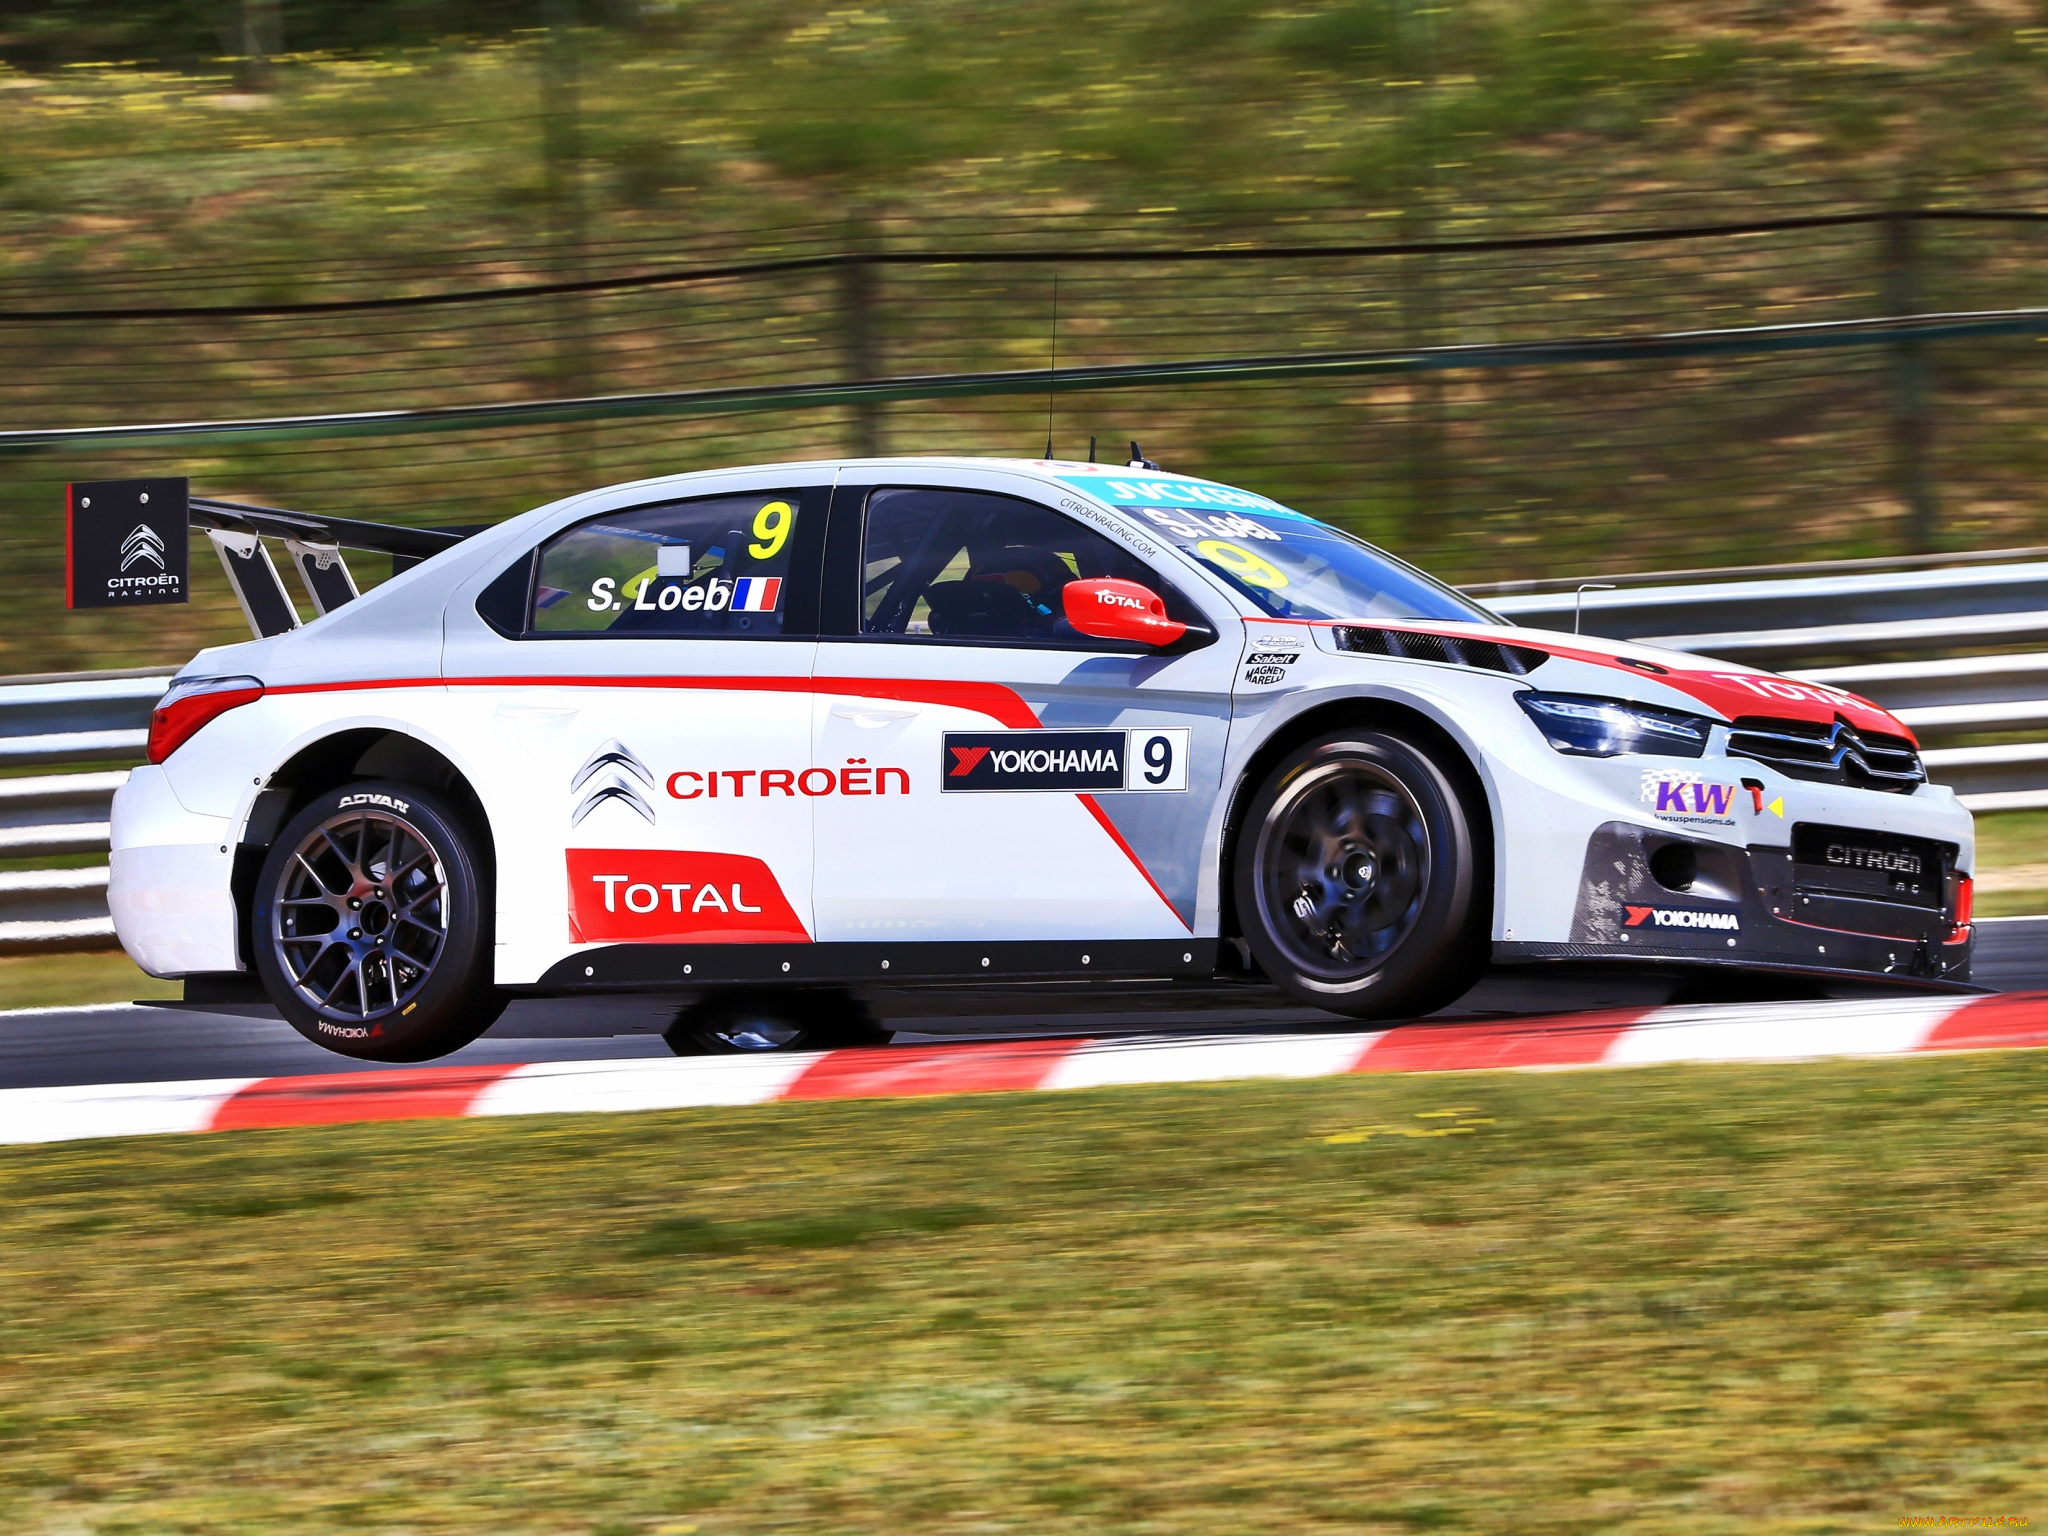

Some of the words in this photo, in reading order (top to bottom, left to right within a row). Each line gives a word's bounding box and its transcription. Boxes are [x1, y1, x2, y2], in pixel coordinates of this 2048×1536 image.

[748, 501, 793, 560] 9
[1060, 498, 1157, 558] CITROENRACING.COM
[1197, 540, 1289, 589] 9
[107, 573, 180, 588] CITROËN
[108, 588, 180, 597] RACING
[587, 577, 622, 612] S.
[634, 578, 731, 612] Loeb
[1095, 590, 1146, 610] TOTAL
[1251, 654, 1294, 664] Sabelt
[1711, 674, 1888, 717] TOTAL
[989, 749, 1119, 773] YOKOHAMA
[1143, 736, 1173, 785] 9
[666, 758, 911, 800] CITROËN
[338, 794, 410, 814] ADVAN
[1656, 781, 1737, 817] KW
[1654, 813, 1736, 827] kwsuspensions.de
[592, 874, 763, 913] TOTAL
[1652, 909, 1740, 931] YOKOHAMA
[318, 1019, 369, 1039] YOKOHAMA
